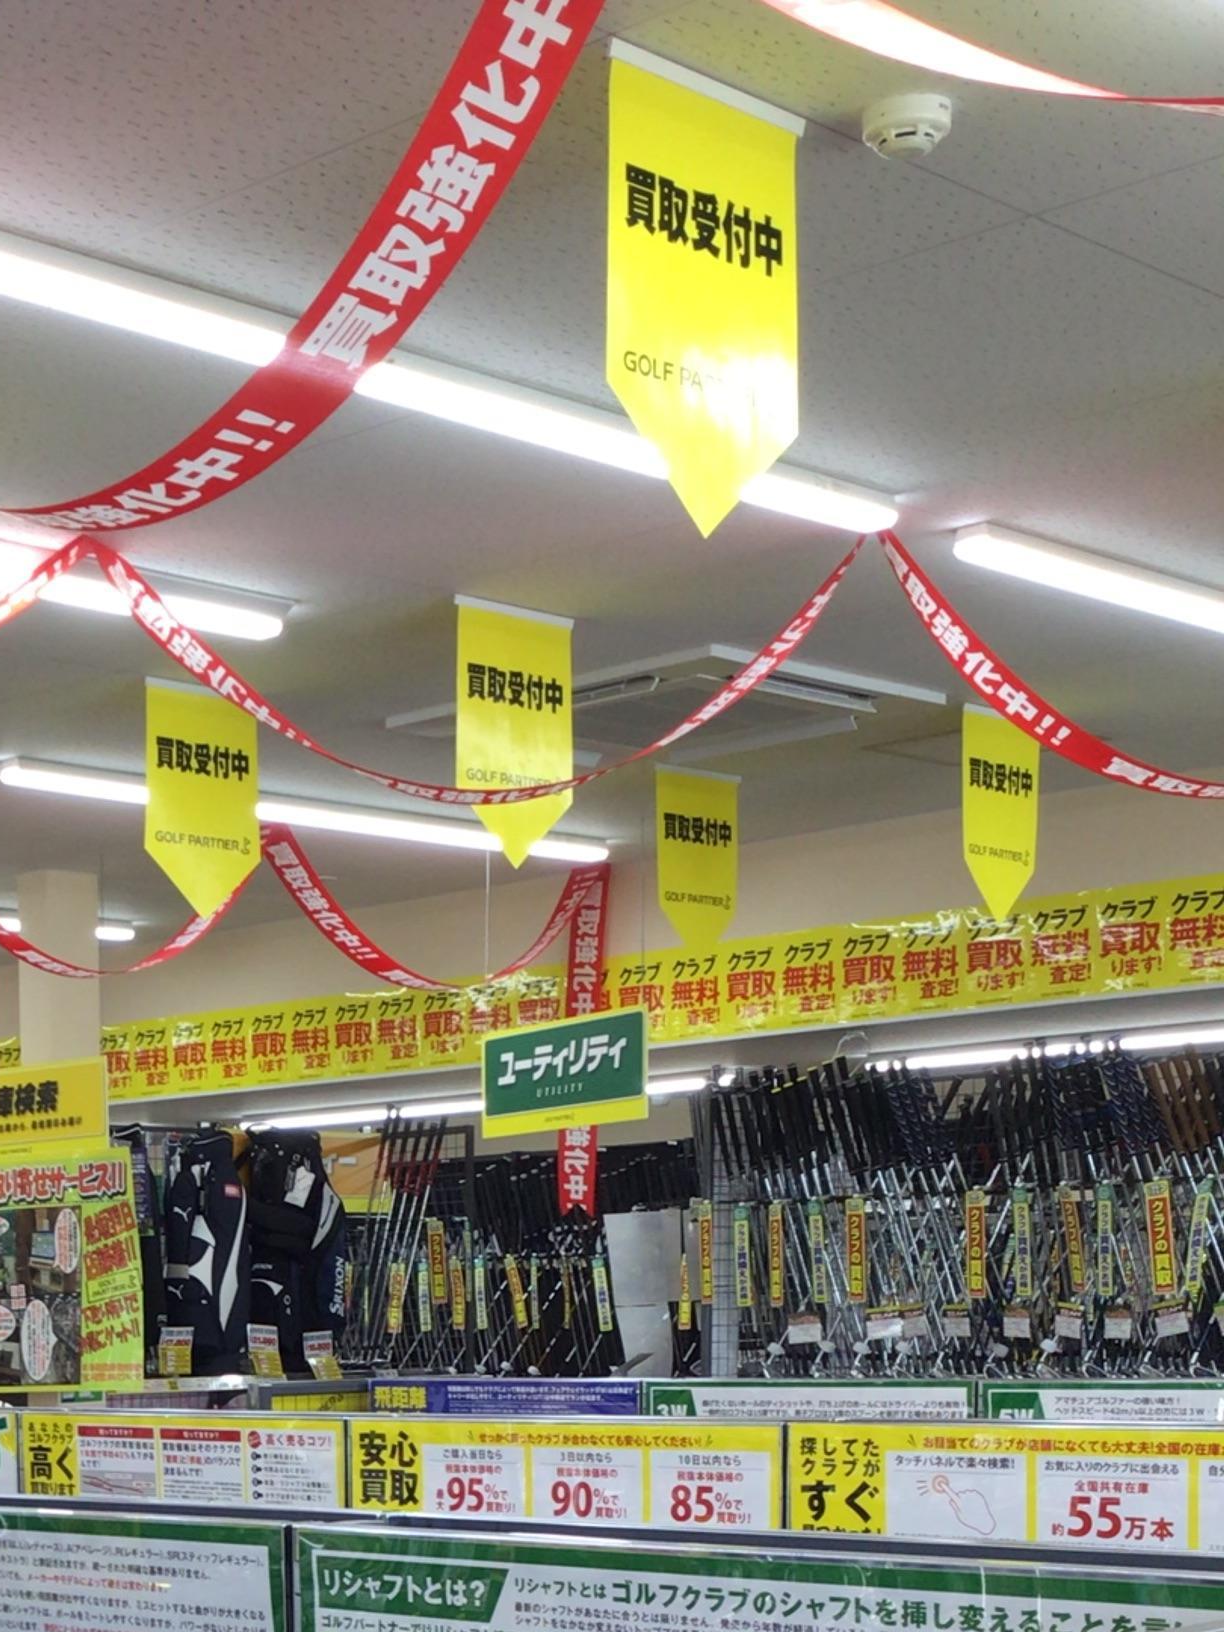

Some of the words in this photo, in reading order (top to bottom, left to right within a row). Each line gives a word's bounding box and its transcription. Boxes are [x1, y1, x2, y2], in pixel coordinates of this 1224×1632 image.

[624, 163, 783, 276] 買取受付中
[623, 351, 674, 382] GOLF
[467, 664, 563, 713] 買取受付中
[156, 737, 249, 780] 買取受付中
[466, 767, 496, 782] GOLF
[969, 757, 1033, 797] 買取受付中
[155, 830, 185, 845] GOLF
[188, 834, 240, 852] PARTNER
[663, 812, 731, 848] 買取受付中
[969, 843, 987, 857] GOLF
[664, 891, 686, 903] GOLF
[687, 893, 724, 907] PARTNER
[1101, 895, 1158, 923] クラブ
[1034, 905, 1088, 932] クラブ
[785, 938, 833, 962] クラブ
[843, 932, 892, 957] クラブ
[966, 939, 1023, 972] 買取
[1100, 922, 1161, 956] 買取
[620, 962, 662, 986] クラブ
[672, 954, 718, 977] クラブ
[728, 947, 773, 970] クラブ
[842, 953, 896, 986] 買取
[902, 944, 959, 980] 無料
[671, 977, 719, 1010] 無料
[726, 970, 775, 1001] 買取
[782, 960, 836, 994] 無料
[498, 1034, 626, 1085] ユーティリティ
[29, 1445, 74, 1481] 高く
[360, 1432, 418, 1466] 安心
[800, 1438, 880, 1457] 探してた
[800, 1458, 881, 1477] クラブが
[360, 1469, 419, 1507] 買取
[800, 1479, 879, 1522] すぐ
[323, 1569, 487, 1607] リシャフトとは?
[514, 1577, 606, 1599] リシャフトとは
